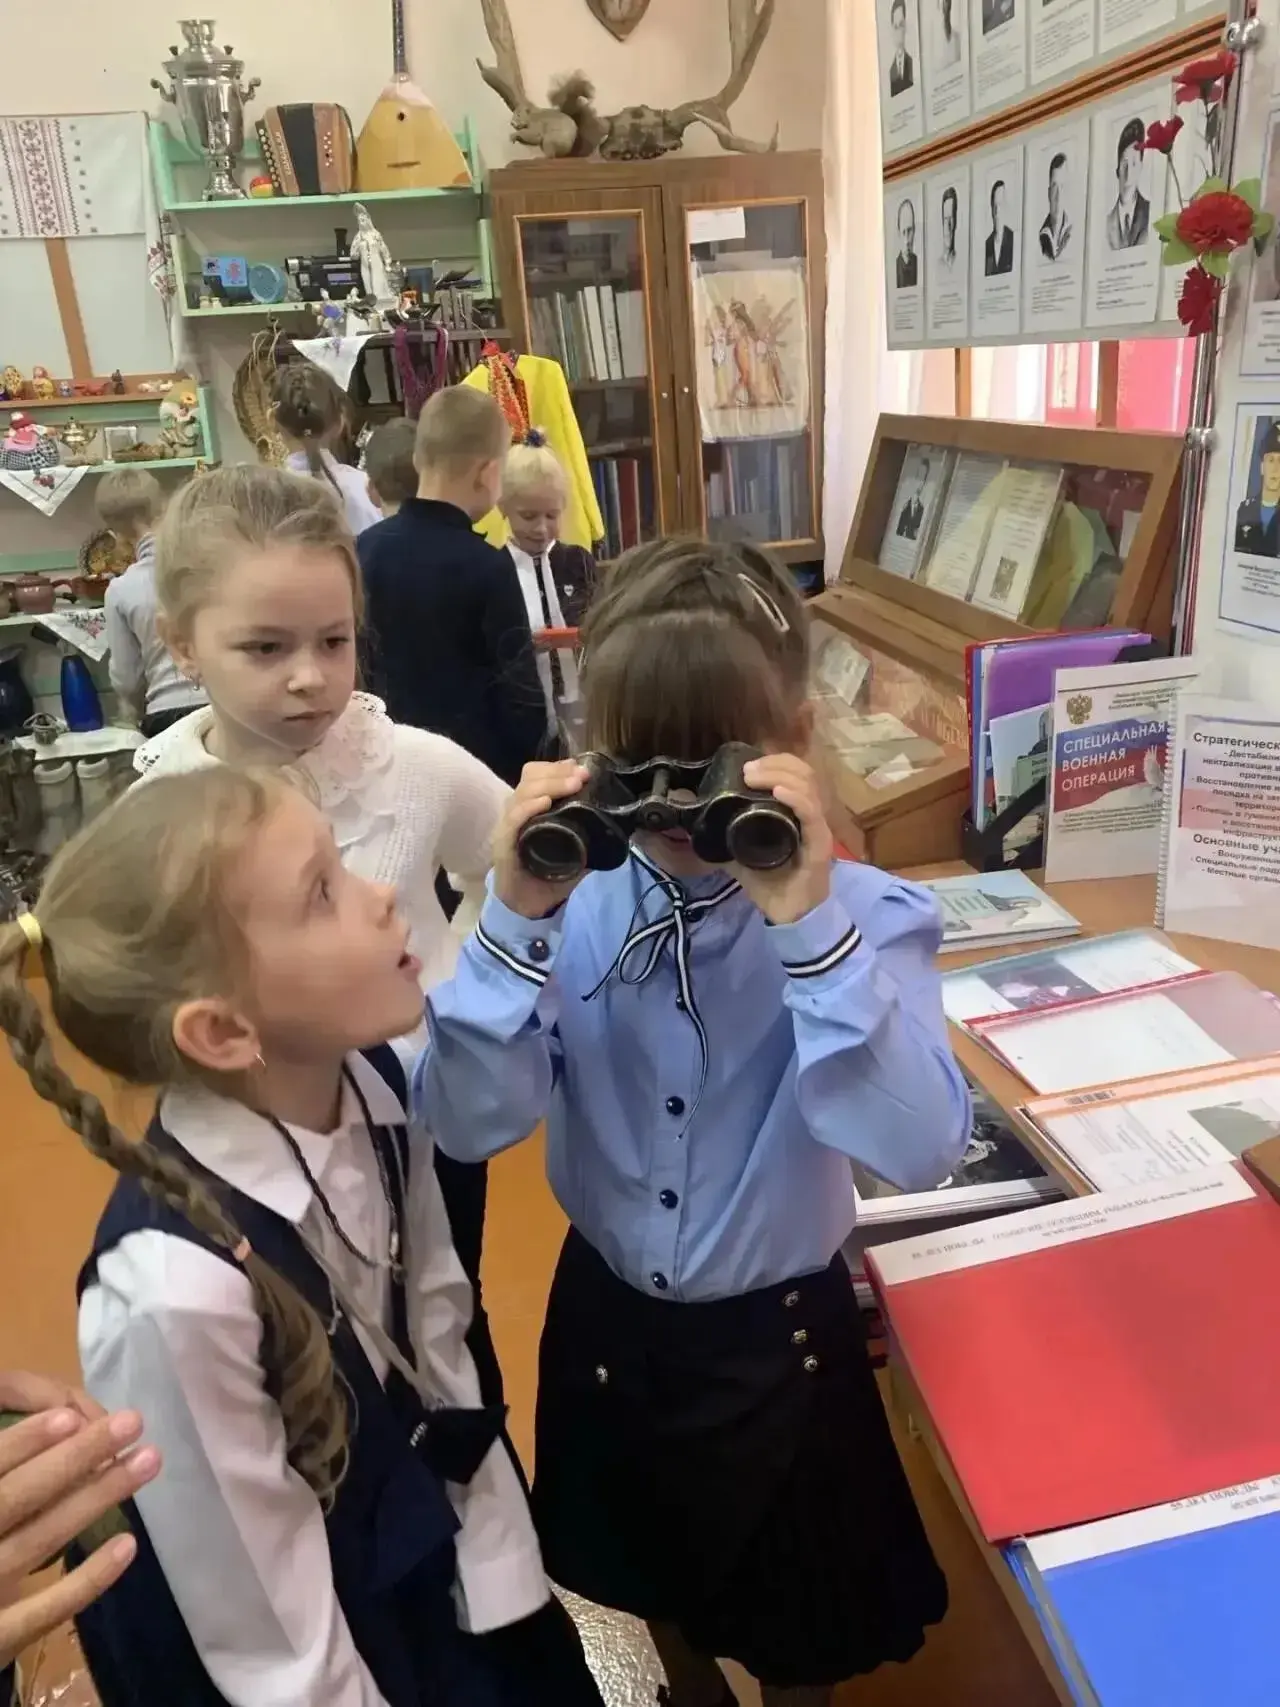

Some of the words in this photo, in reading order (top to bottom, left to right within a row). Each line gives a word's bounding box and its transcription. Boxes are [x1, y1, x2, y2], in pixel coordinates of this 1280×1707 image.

[1063, 722, 1166, 754] СПЕЦИАЛЬНАЯ
[1062, 748, 1127, 772] ВОЕННАЯ
[1062, 765, 1136, 791] ОПЕРАЦИЯ
[1193, 833, 1259, 851] Основные
[1195, 855, 1257, 871] Специальные
[1207, 867, 1247, 879] Местные
